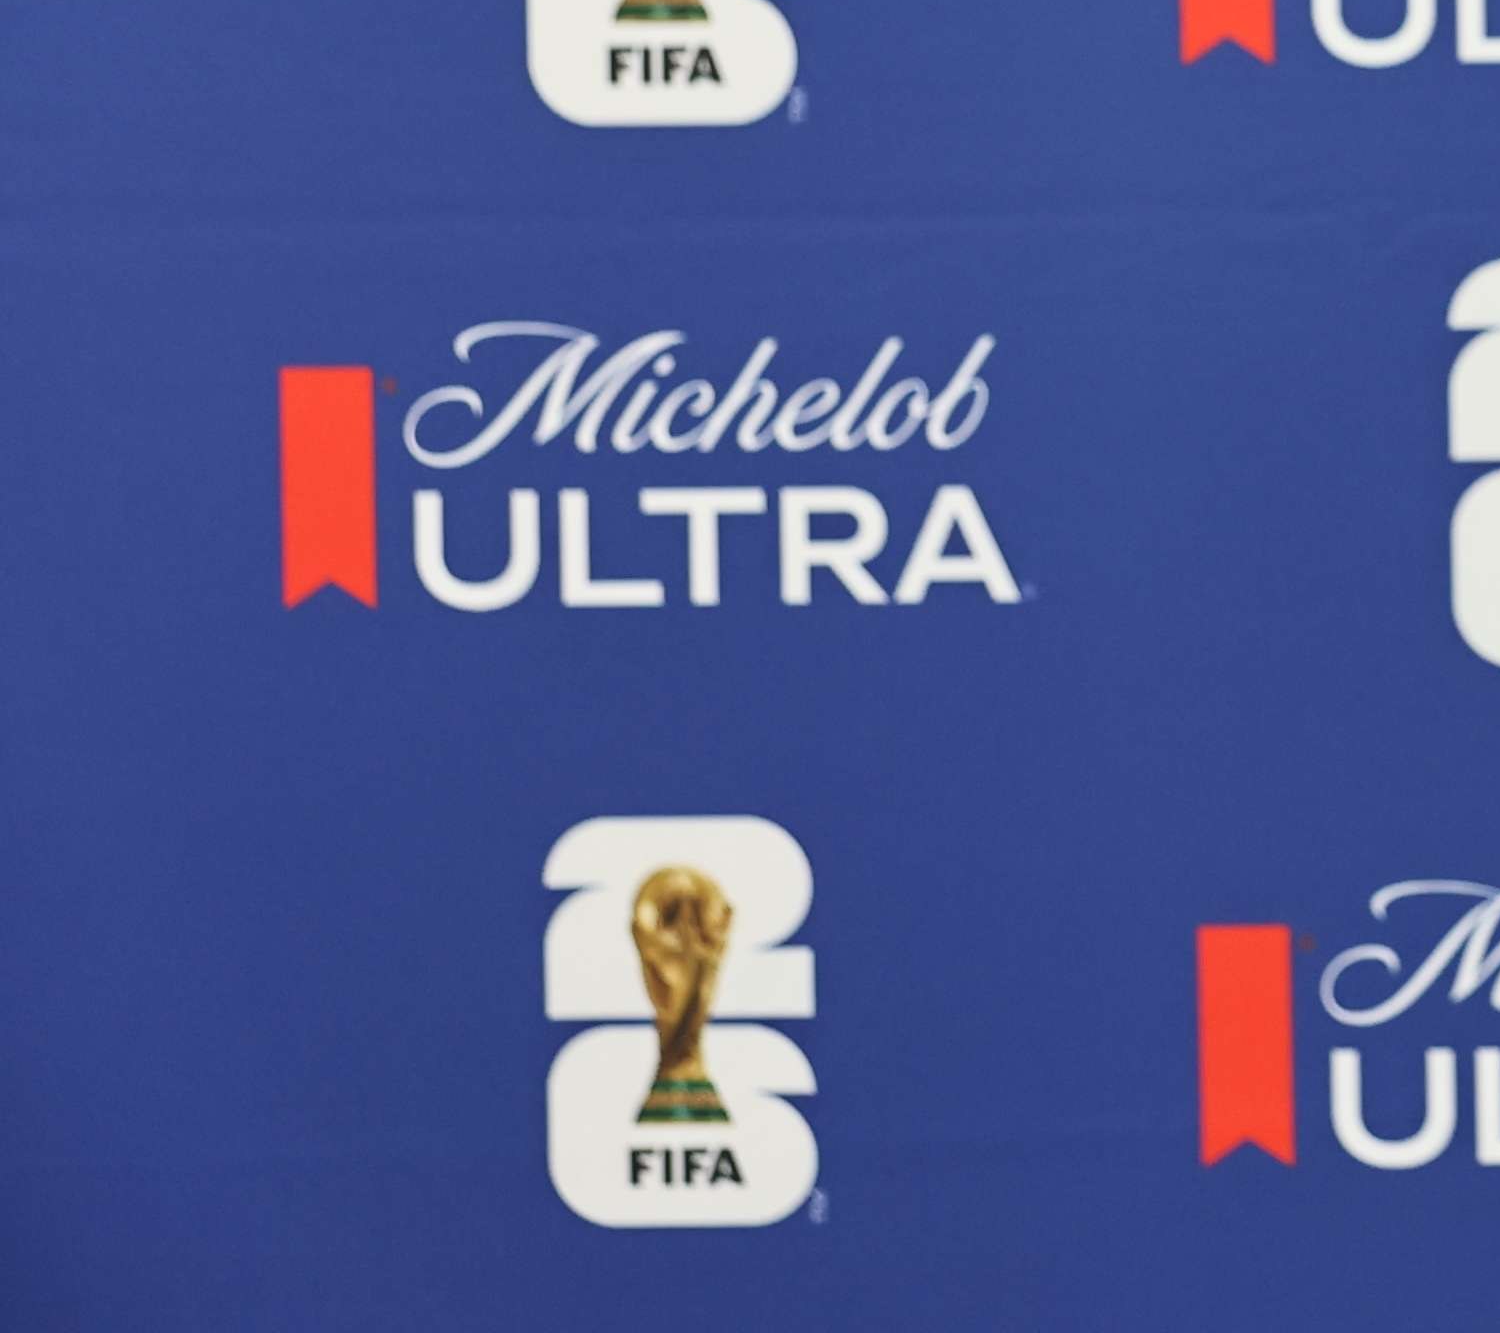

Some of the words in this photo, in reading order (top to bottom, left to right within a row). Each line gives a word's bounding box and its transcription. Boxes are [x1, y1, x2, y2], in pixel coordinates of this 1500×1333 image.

[609, 46, 721, 84] FIFA
[404, 322, 994, 468] Michelob
[414, 485, 1021, 611] ULTRA
[629, 1148, 743, 1186] FIFA
